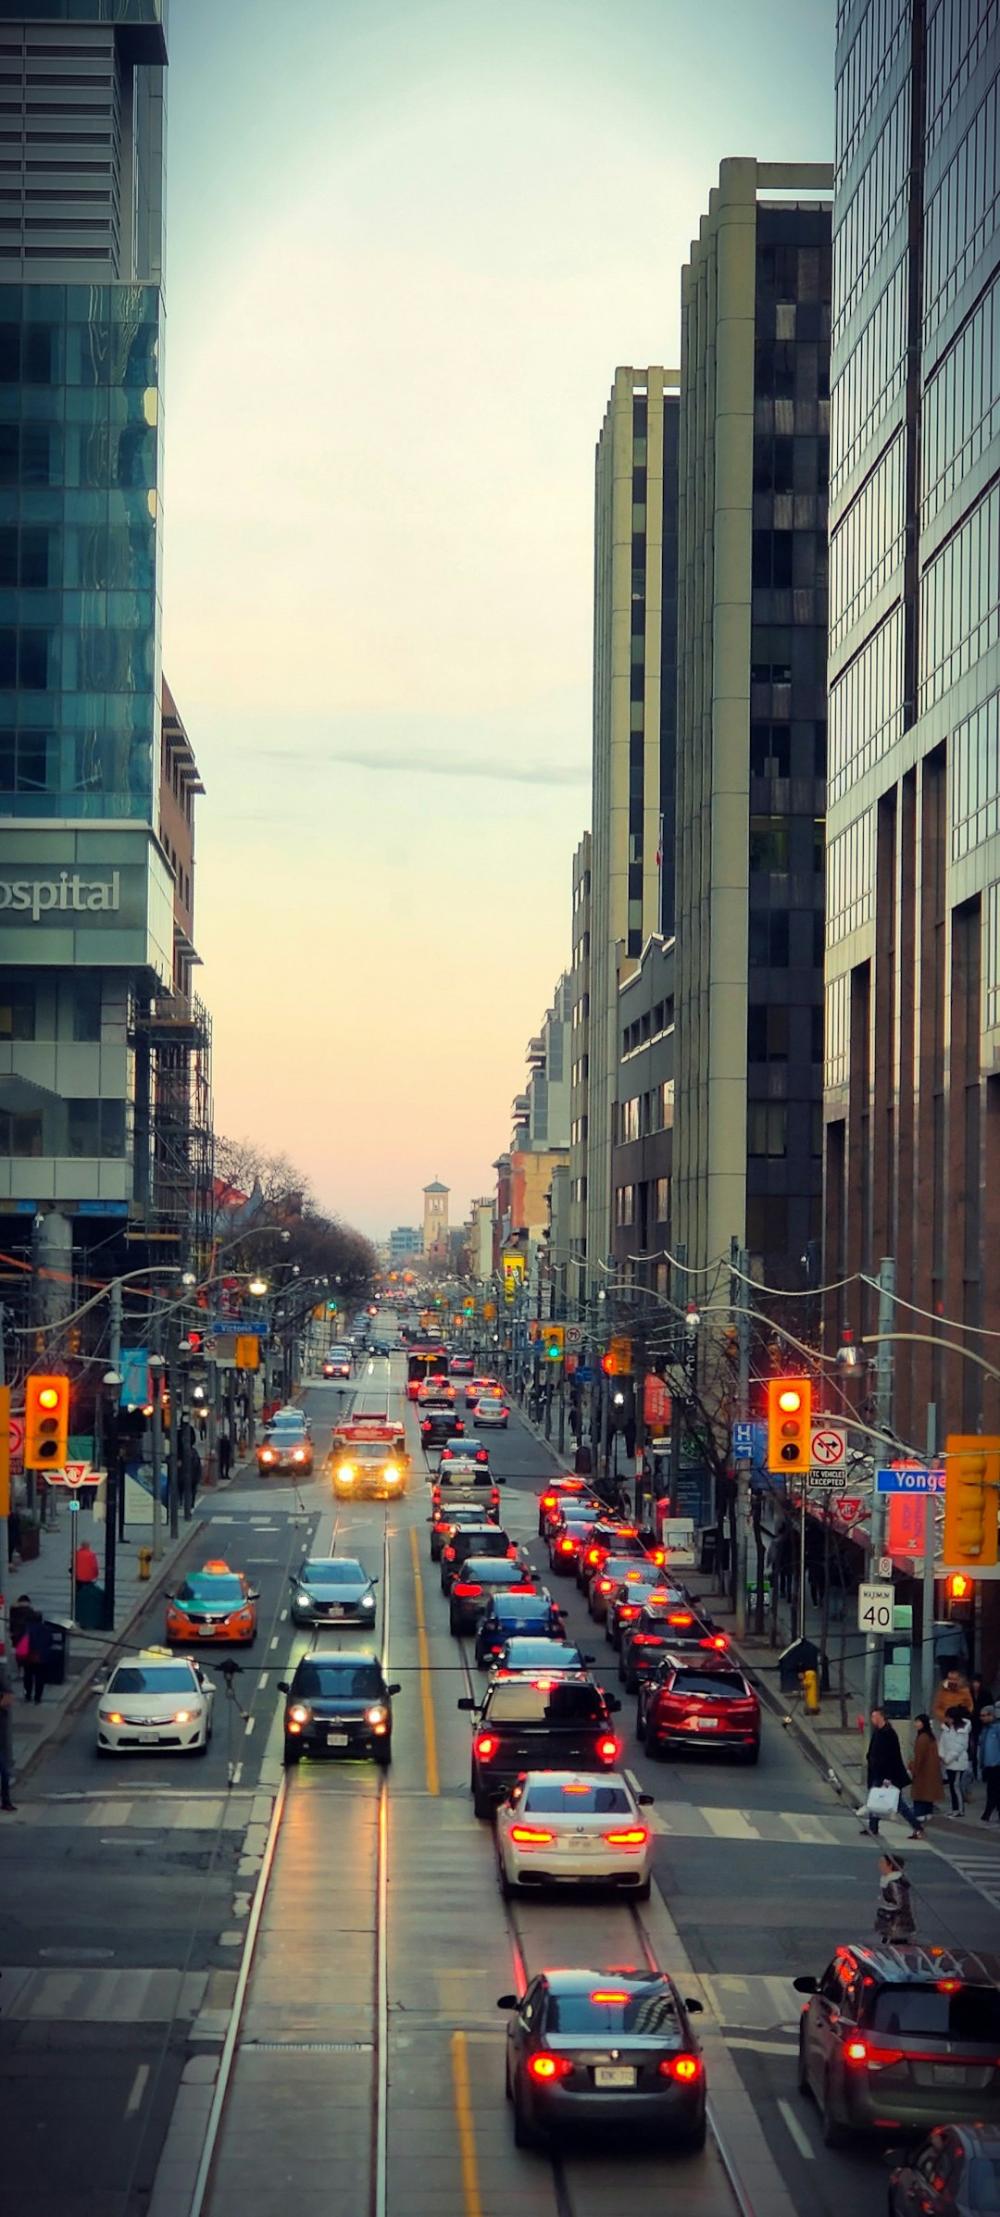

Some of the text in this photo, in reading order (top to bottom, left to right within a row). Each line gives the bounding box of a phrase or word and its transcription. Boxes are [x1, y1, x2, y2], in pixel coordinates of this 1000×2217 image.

[737, 1424, 751, 1441] H
[895, 1472, 946, 1492] Yonge
[863, 1606, 890, 1626] 40
